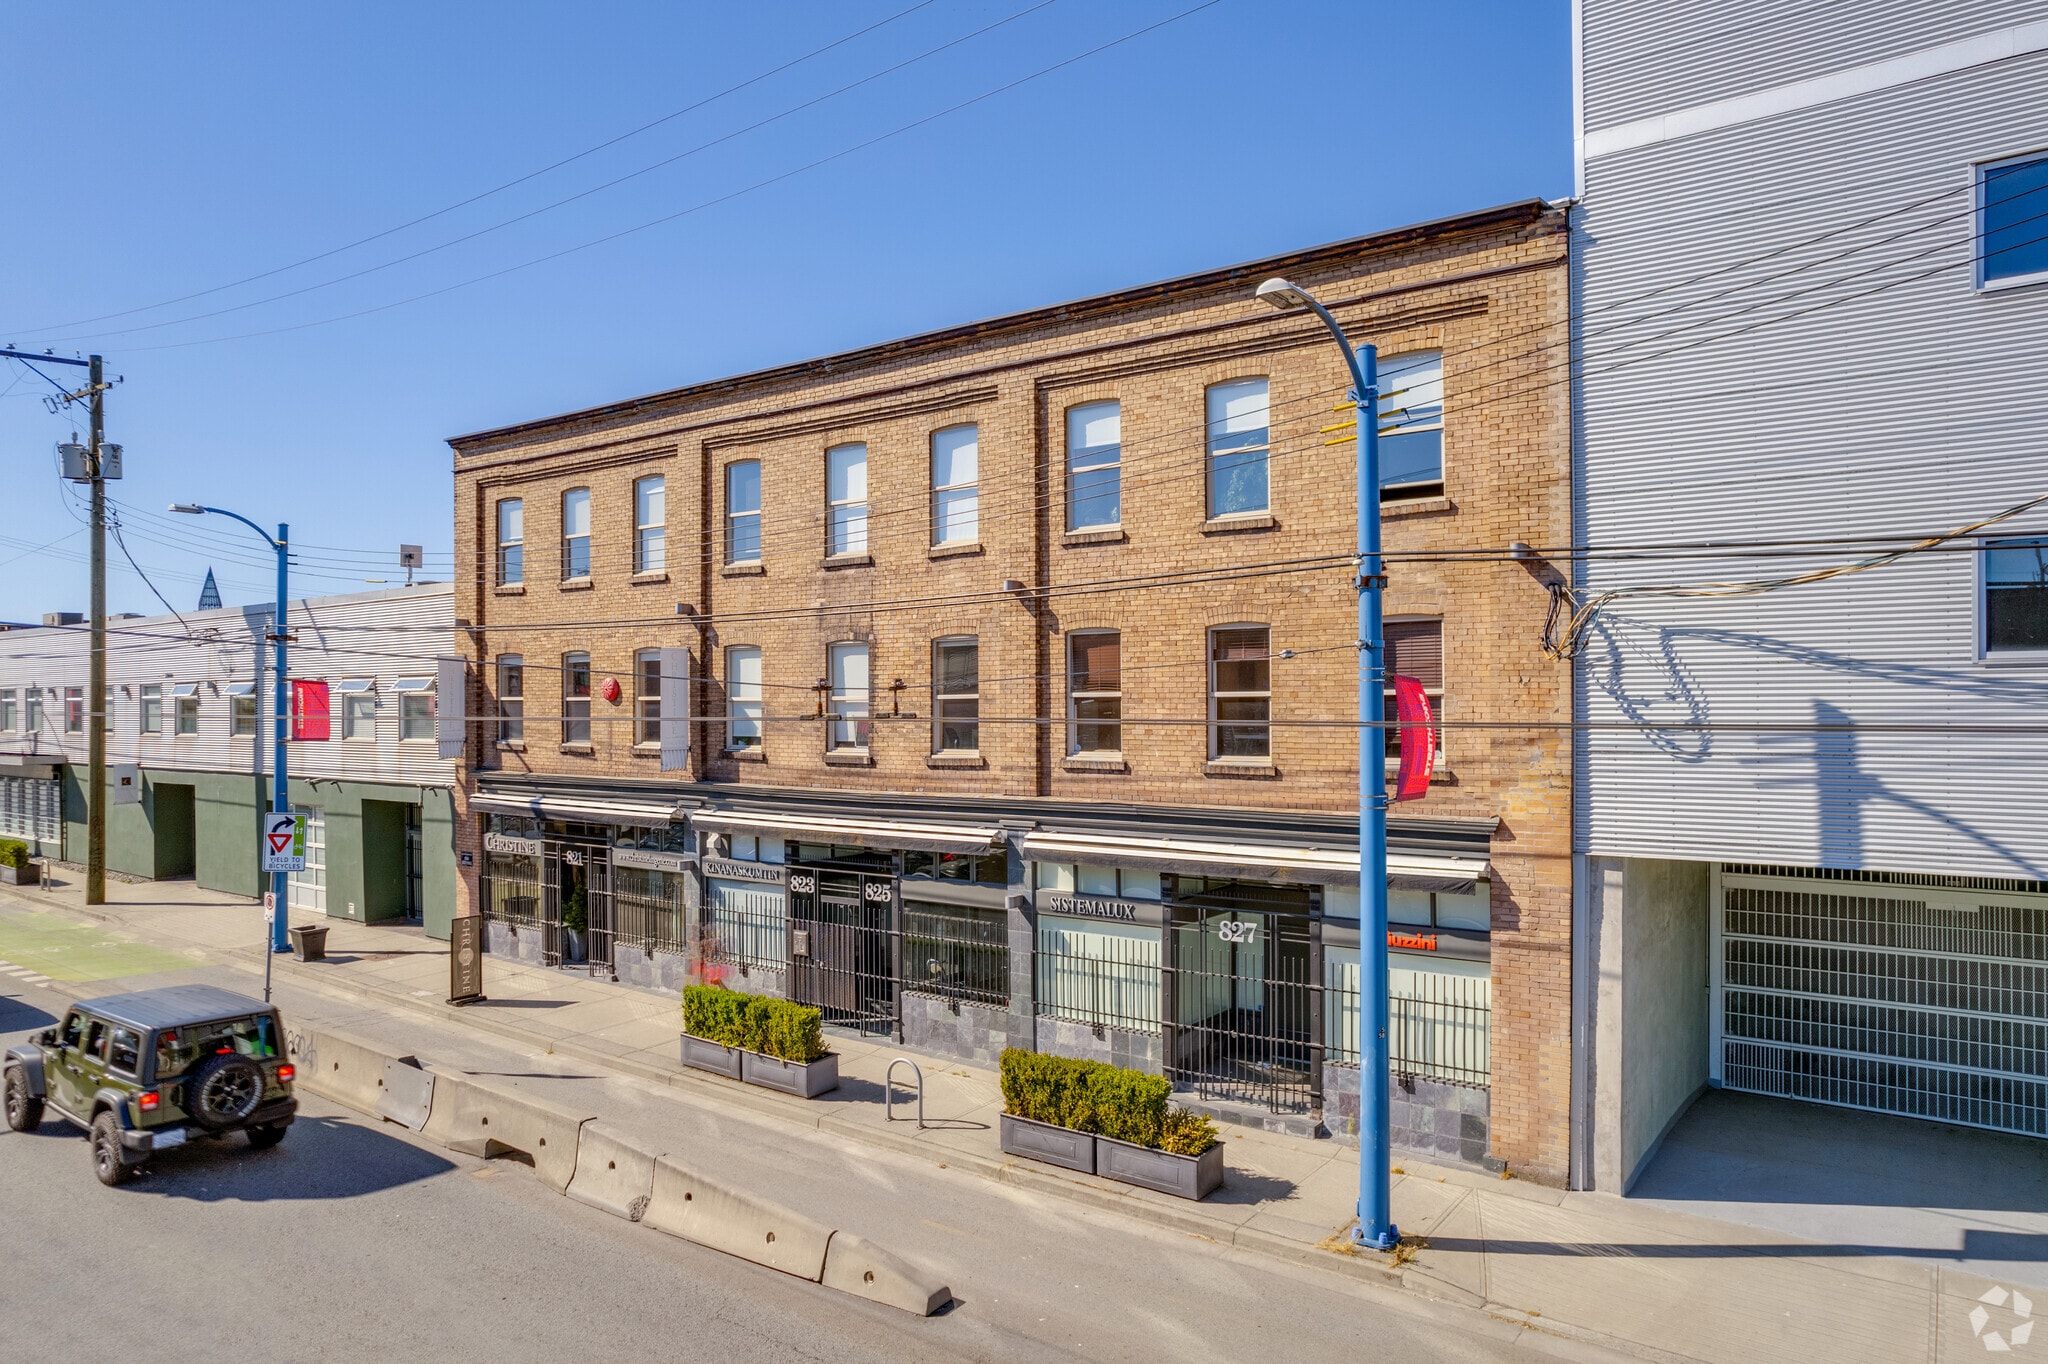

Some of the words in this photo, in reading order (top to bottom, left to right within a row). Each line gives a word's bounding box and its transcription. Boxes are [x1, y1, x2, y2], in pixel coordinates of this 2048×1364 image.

[486, 835, 535, 854] CHRISTINE
[566, 850, 584, 866] 821
[790, 875, 815, 893] 823
[865, 883, 891, 902] 825
[1050, 896, 1135, 920] SISTEMALUX
[1218, 920, 1258, 944] 827
[461, 919, 471, 992] CHRISTINE
